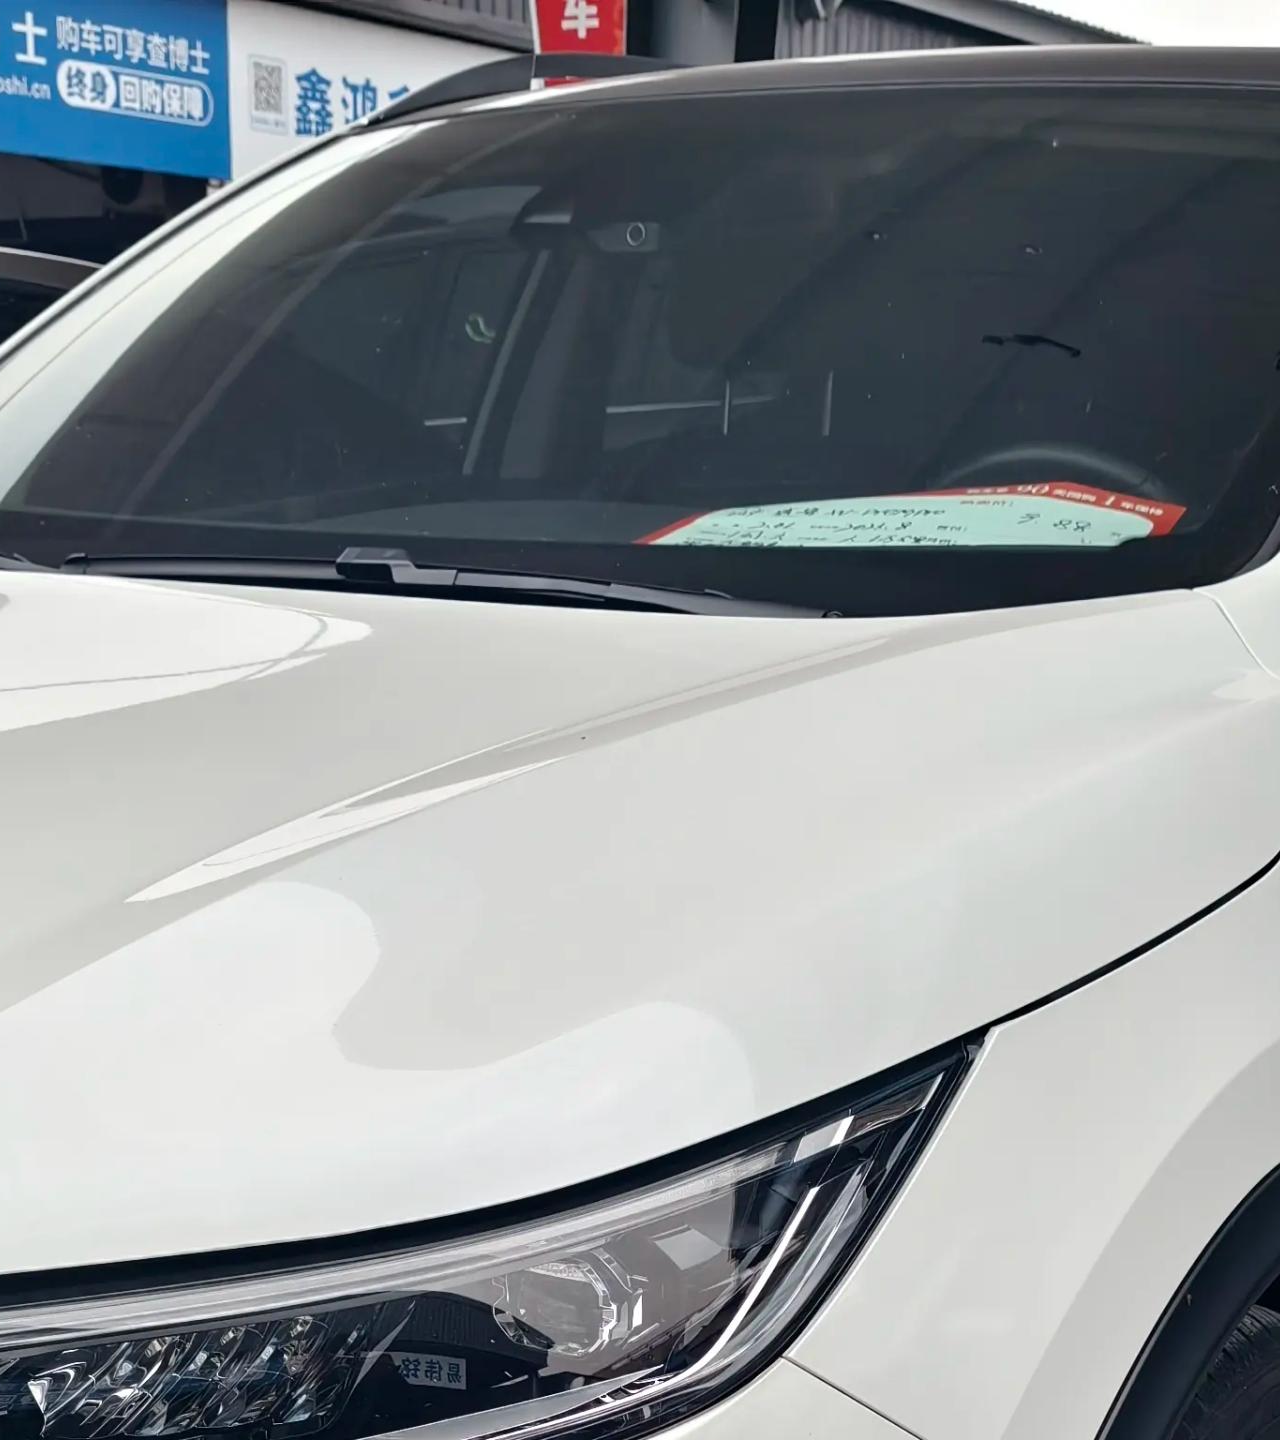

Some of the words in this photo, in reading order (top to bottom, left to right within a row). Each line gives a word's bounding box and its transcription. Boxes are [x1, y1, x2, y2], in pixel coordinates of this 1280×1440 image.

[56, 15, 210, 75] 购车可享查博士
[66, 66, 108, 103] 终身
[295, 67, 410, 137] 鑫鸿
